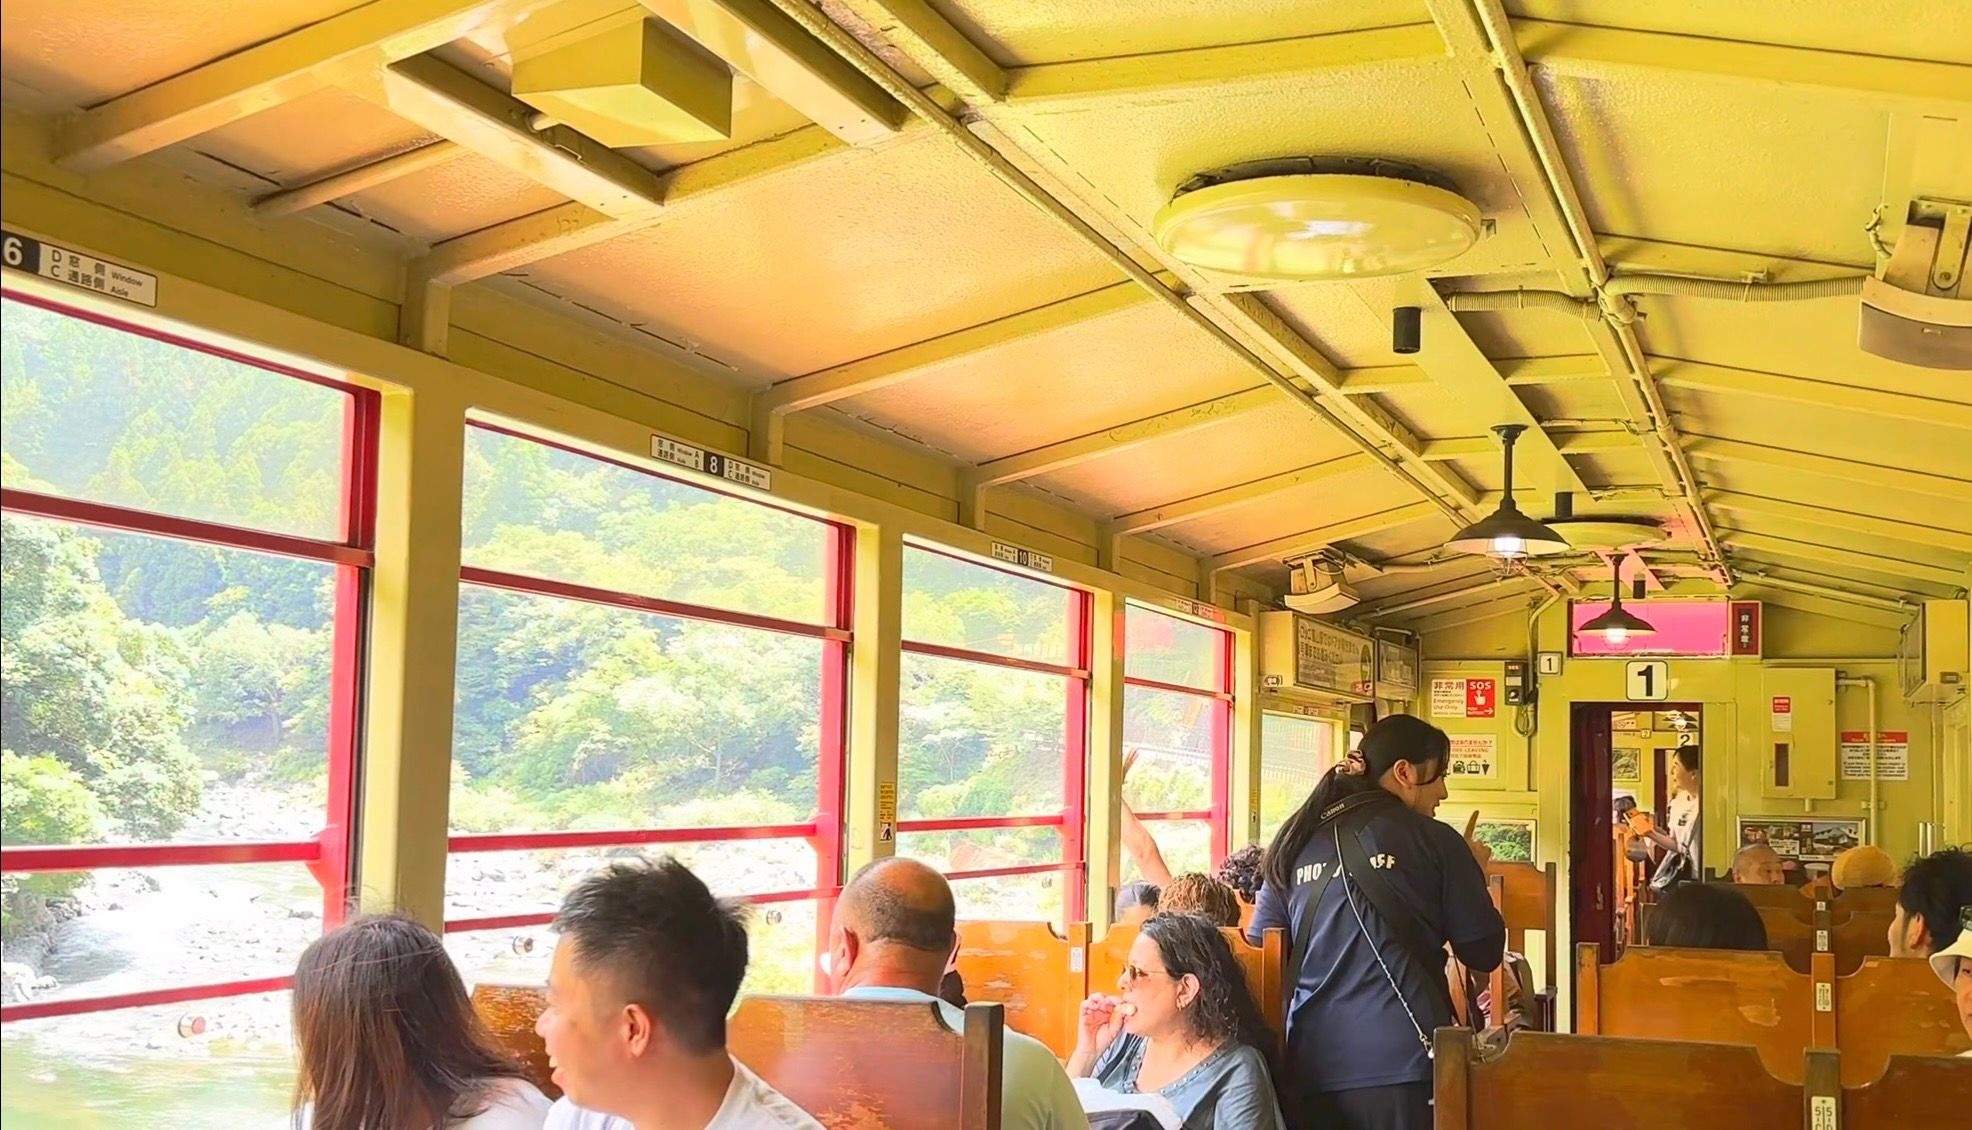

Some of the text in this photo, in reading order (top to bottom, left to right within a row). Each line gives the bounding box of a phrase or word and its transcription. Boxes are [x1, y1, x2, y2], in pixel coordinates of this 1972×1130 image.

[4, 237, 23, 266] 6
[52, 250, 62, 262] D
[111, 271, 143, 287] Window
[51, 265, 60, 278] C
[111, 286, 129, 297] Aisle
[709, 455, 718, 473] 8
[1019, 551, 1027, 565] 10
[1547, 657, 1552, 671] 1
[1433, 681, 1465, 690] 非常用
[1469, 681, 1492, 690] SOS
[1637, 665, 1653, 697] 1
[1681, 734, 1690, 746] 2
[1321, 803, 1345, 820] Canon
